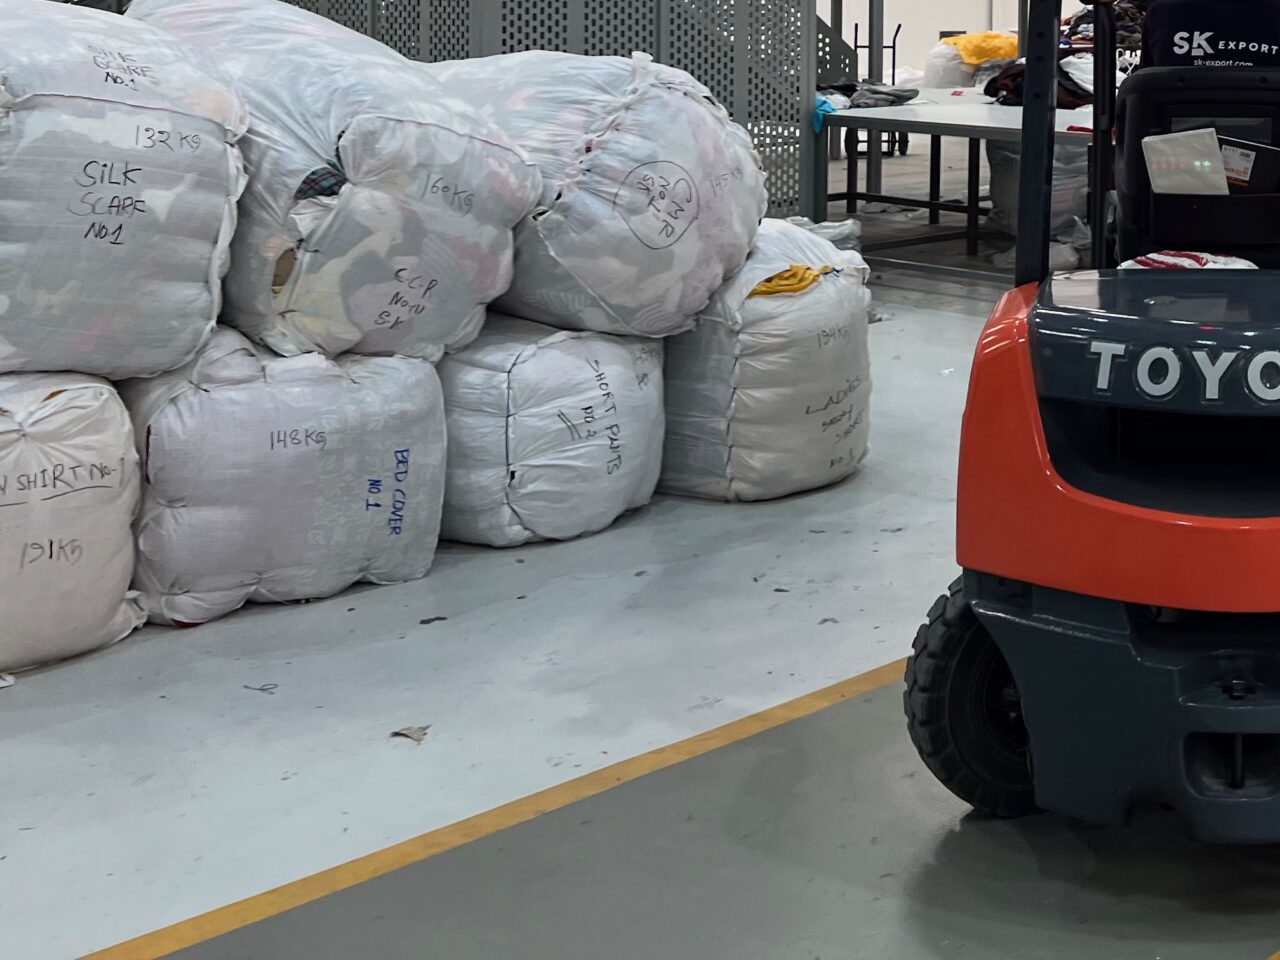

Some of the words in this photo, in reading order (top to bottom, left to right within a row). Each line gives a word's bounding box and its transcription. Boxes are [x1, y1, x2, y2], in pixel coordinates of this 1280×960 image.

[1173, 31, 1215, 56] SK
[1218, 41, 1279, 55] EXPORT
[16, 463, 82, 491] SHIRT
[394, 448, 410, 483] BED
[388, 489, 406, 536] COVER
